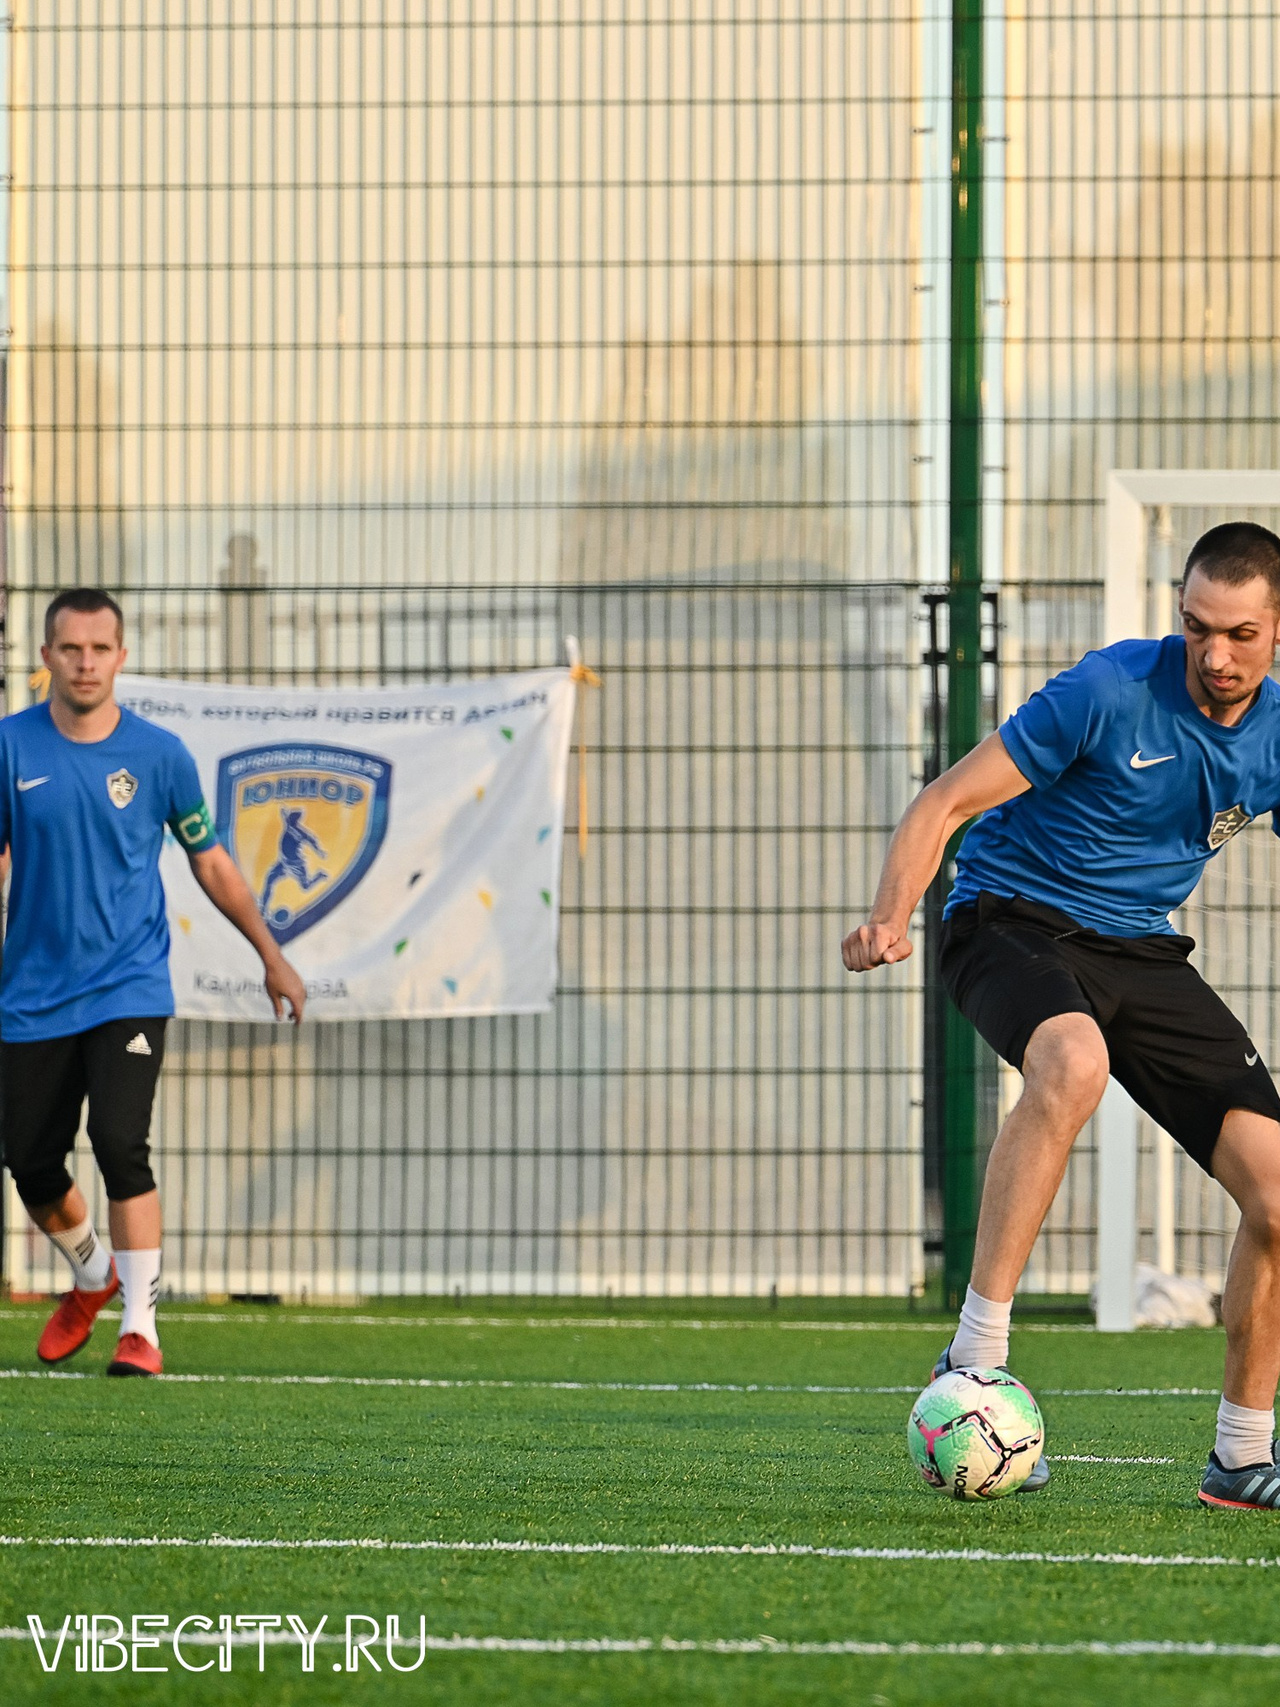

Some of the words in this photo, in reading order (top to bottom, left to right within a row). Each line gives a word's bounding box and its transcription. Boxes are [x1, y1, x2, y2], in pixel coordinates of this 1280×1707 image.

[242, 776, 364, 808] ЮНИОР
[178, 812, 208, 845] C
[1212, 820, 1238, 834] FC
